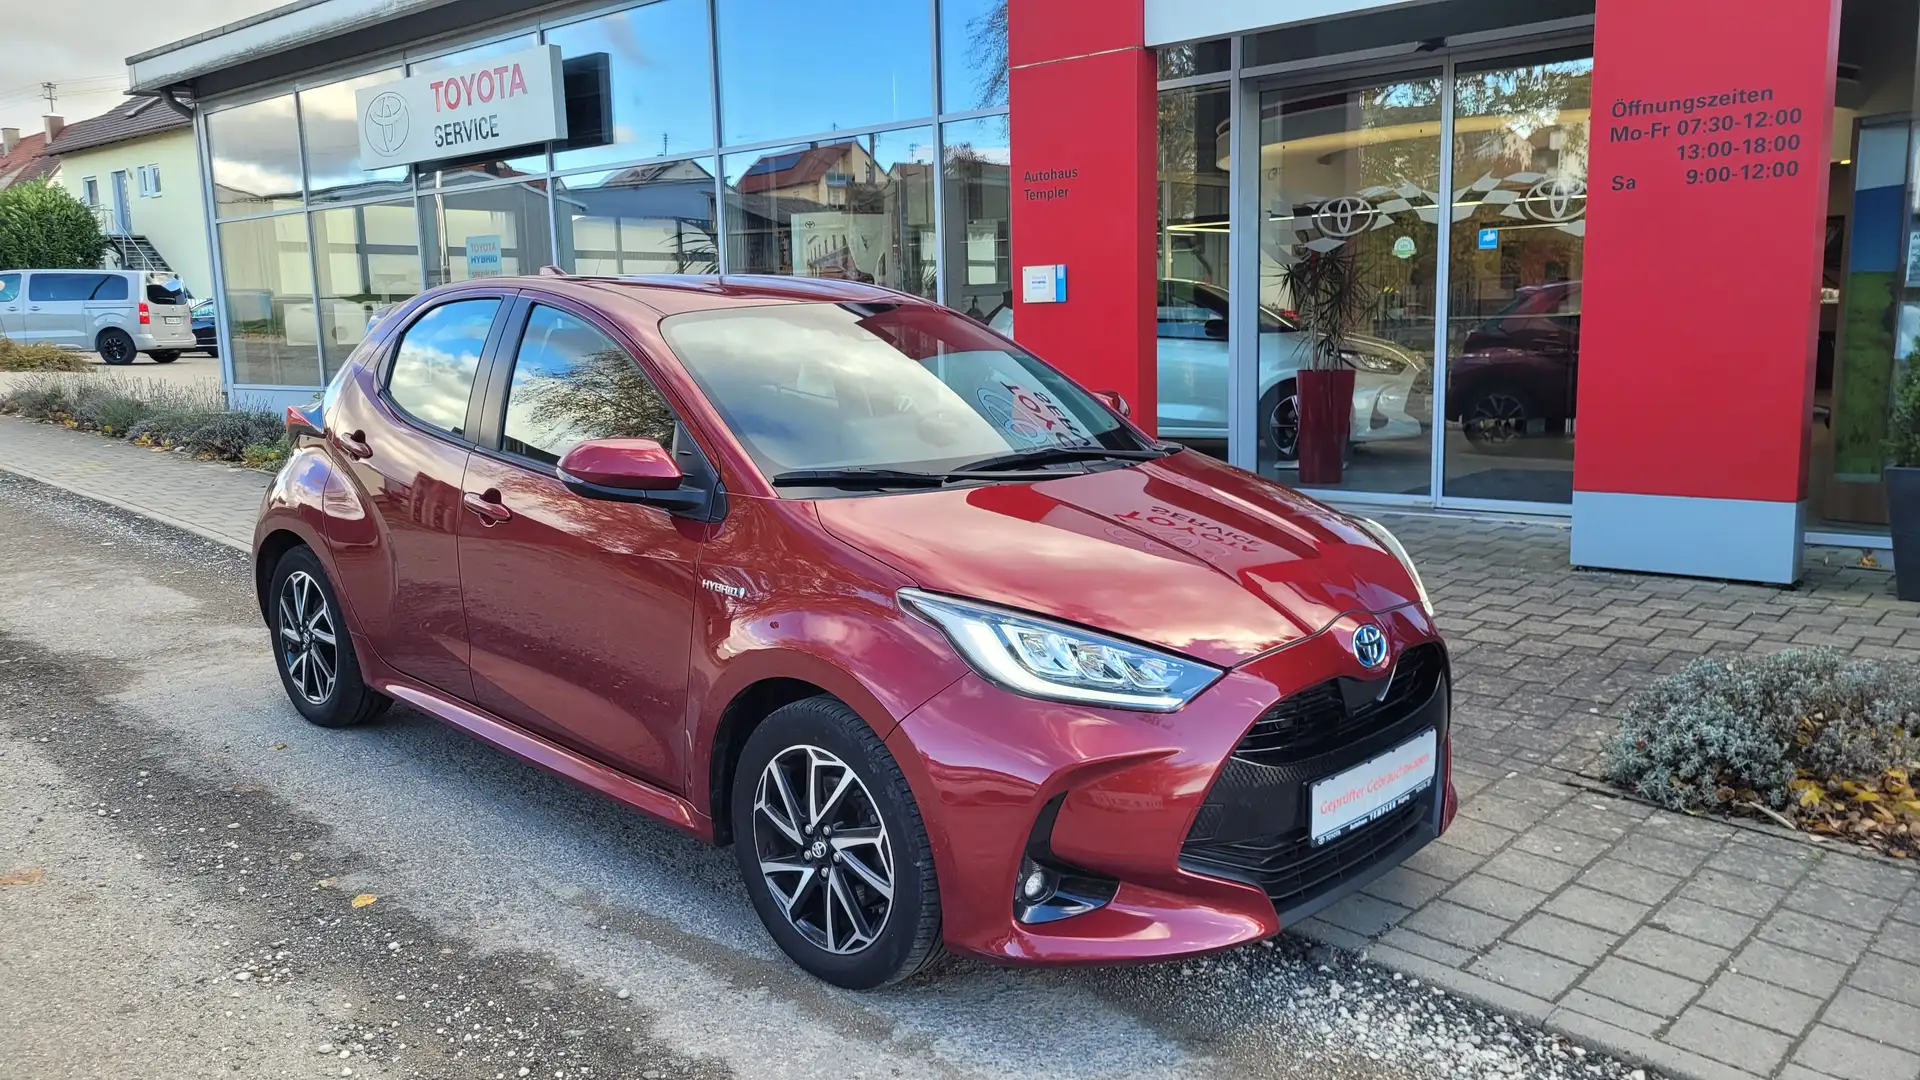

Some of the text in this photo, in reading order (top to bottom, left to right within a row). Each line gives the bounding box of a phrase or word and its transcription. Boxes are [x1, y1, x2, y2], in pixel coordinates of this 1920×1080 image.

[430, 63, 528, 113] TOYOTA
[1611, 88, 1774, 118] Öffnungszeiten
[433, 114, 500, 148] SERVICE
[1610, 107, 1803, 143] Mo-Fr 07:30-12:00
[1677, 134, 1801, 161] 13:00-18:00
[1024, 168, 1078, 183] Autohaus
[1611, 160, 1799, 191] Sa 9:00-12:00
[1024, 187, 1070, 201] Templer
[470, 242, 497, 253] TOYOTA
[470, 254, 498, 264] HYBRID
[701, 579, 739, 597] HYBRID
